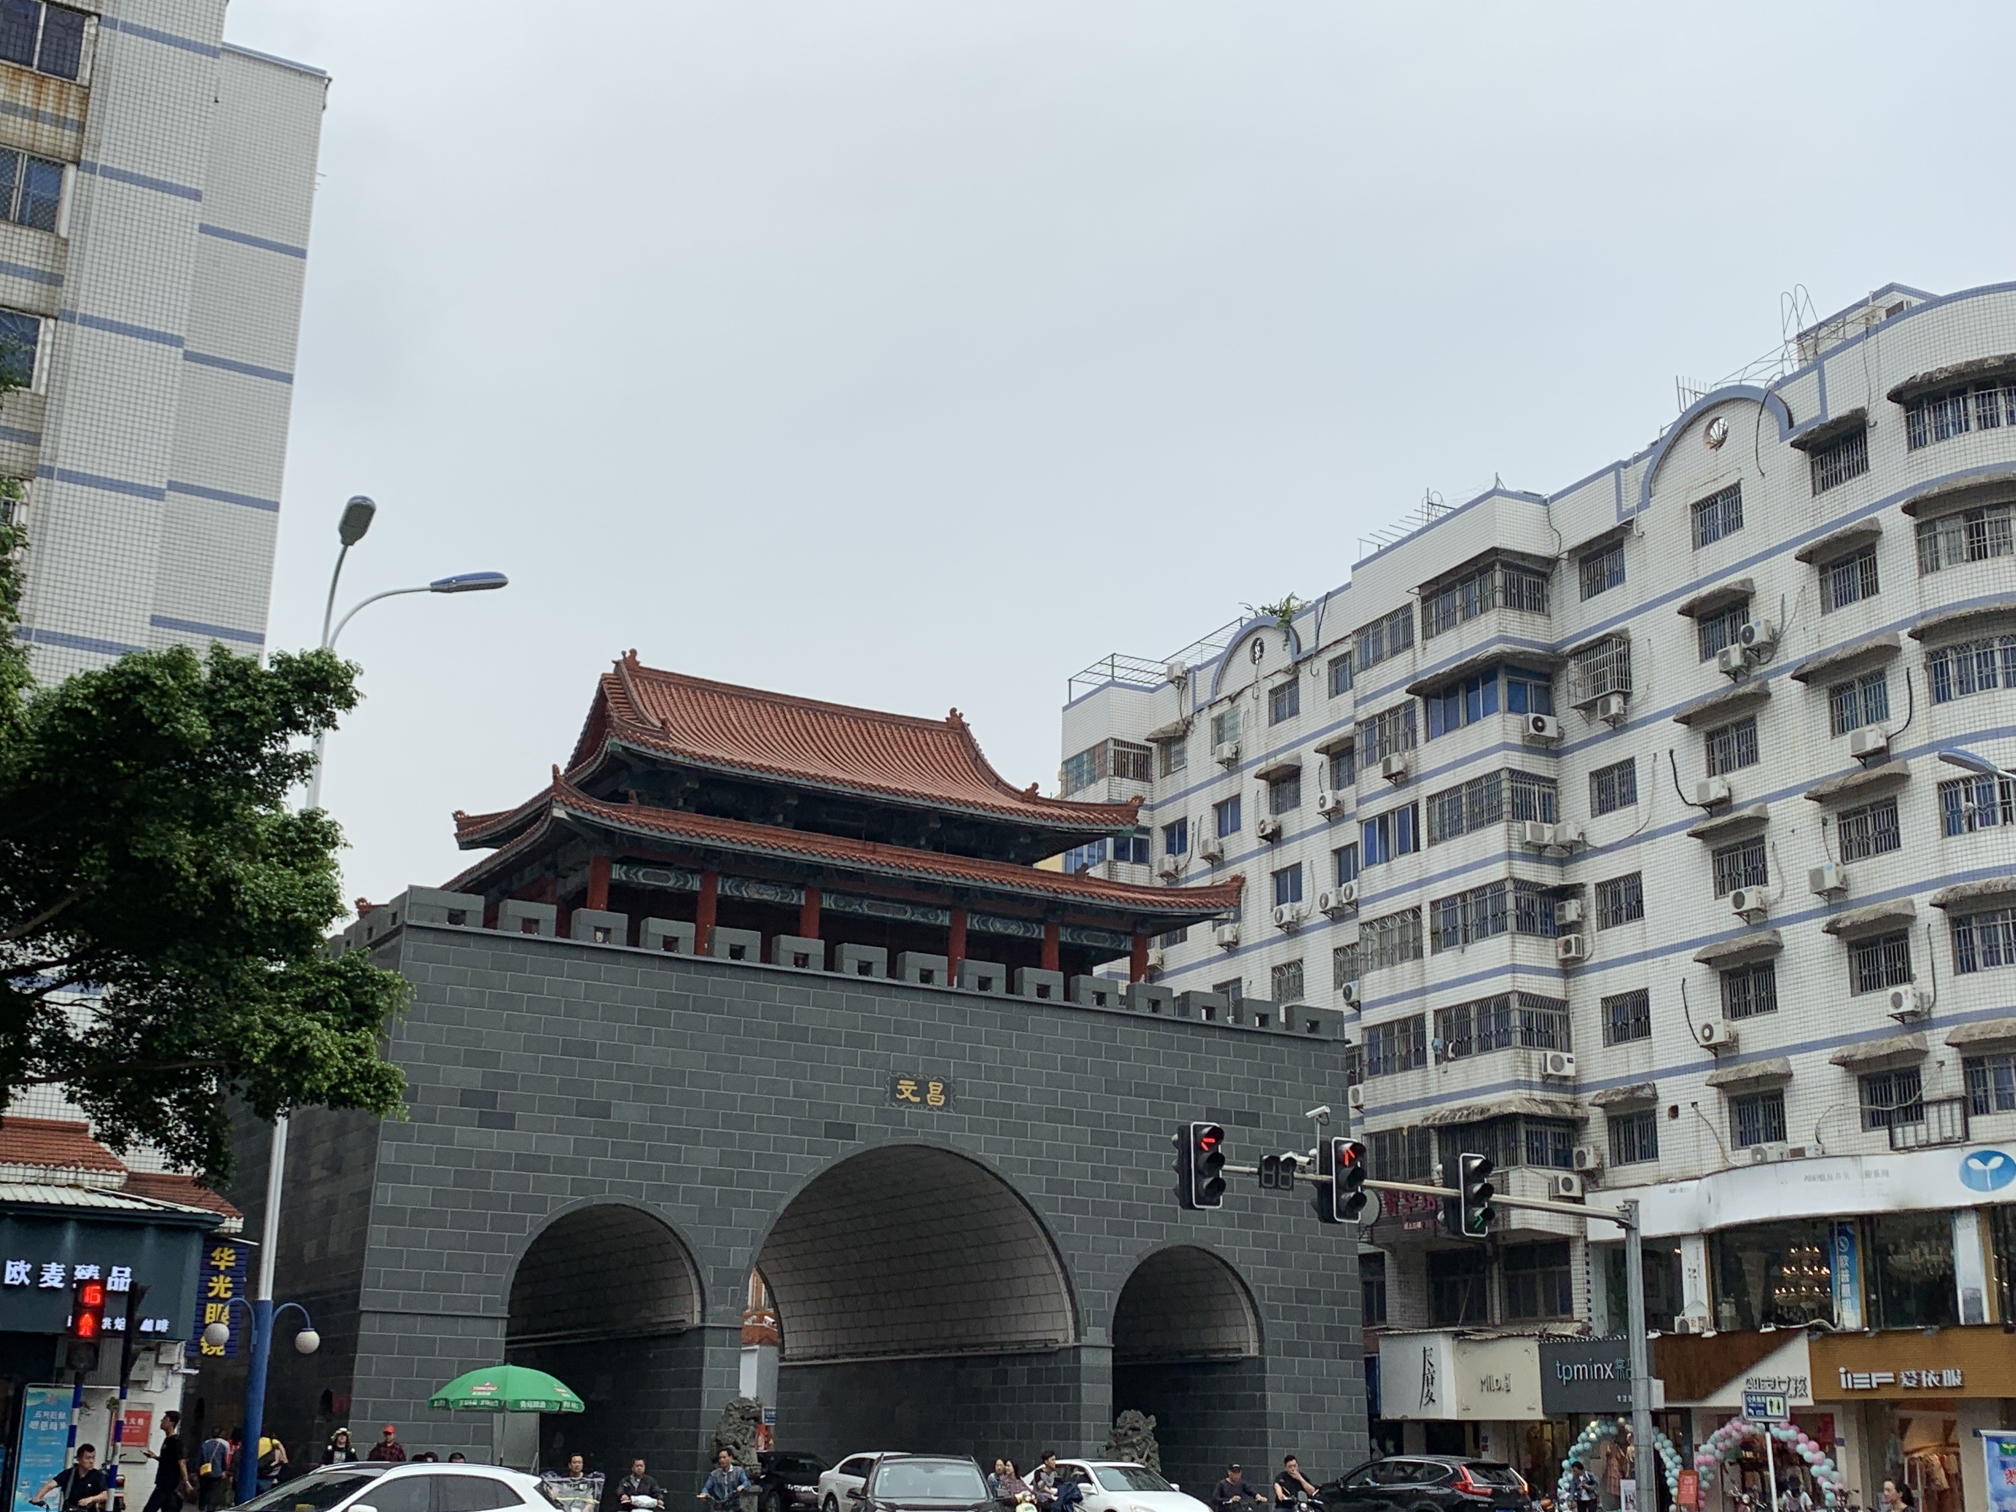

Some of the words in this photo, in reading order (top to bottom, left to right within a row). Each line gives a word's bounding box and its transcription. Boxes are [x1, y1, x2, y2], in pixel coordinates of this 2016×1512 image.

[896, 1079, 945, 1106] 文昌
[4, 1259, 132, 1292] 欧麦臻品
[201, 1247, 236, 1356] 华光眼镜
[1556, 1358, 1614, 1385] tpminx
[1901, 1368, 1963, 1388] 爱依服
